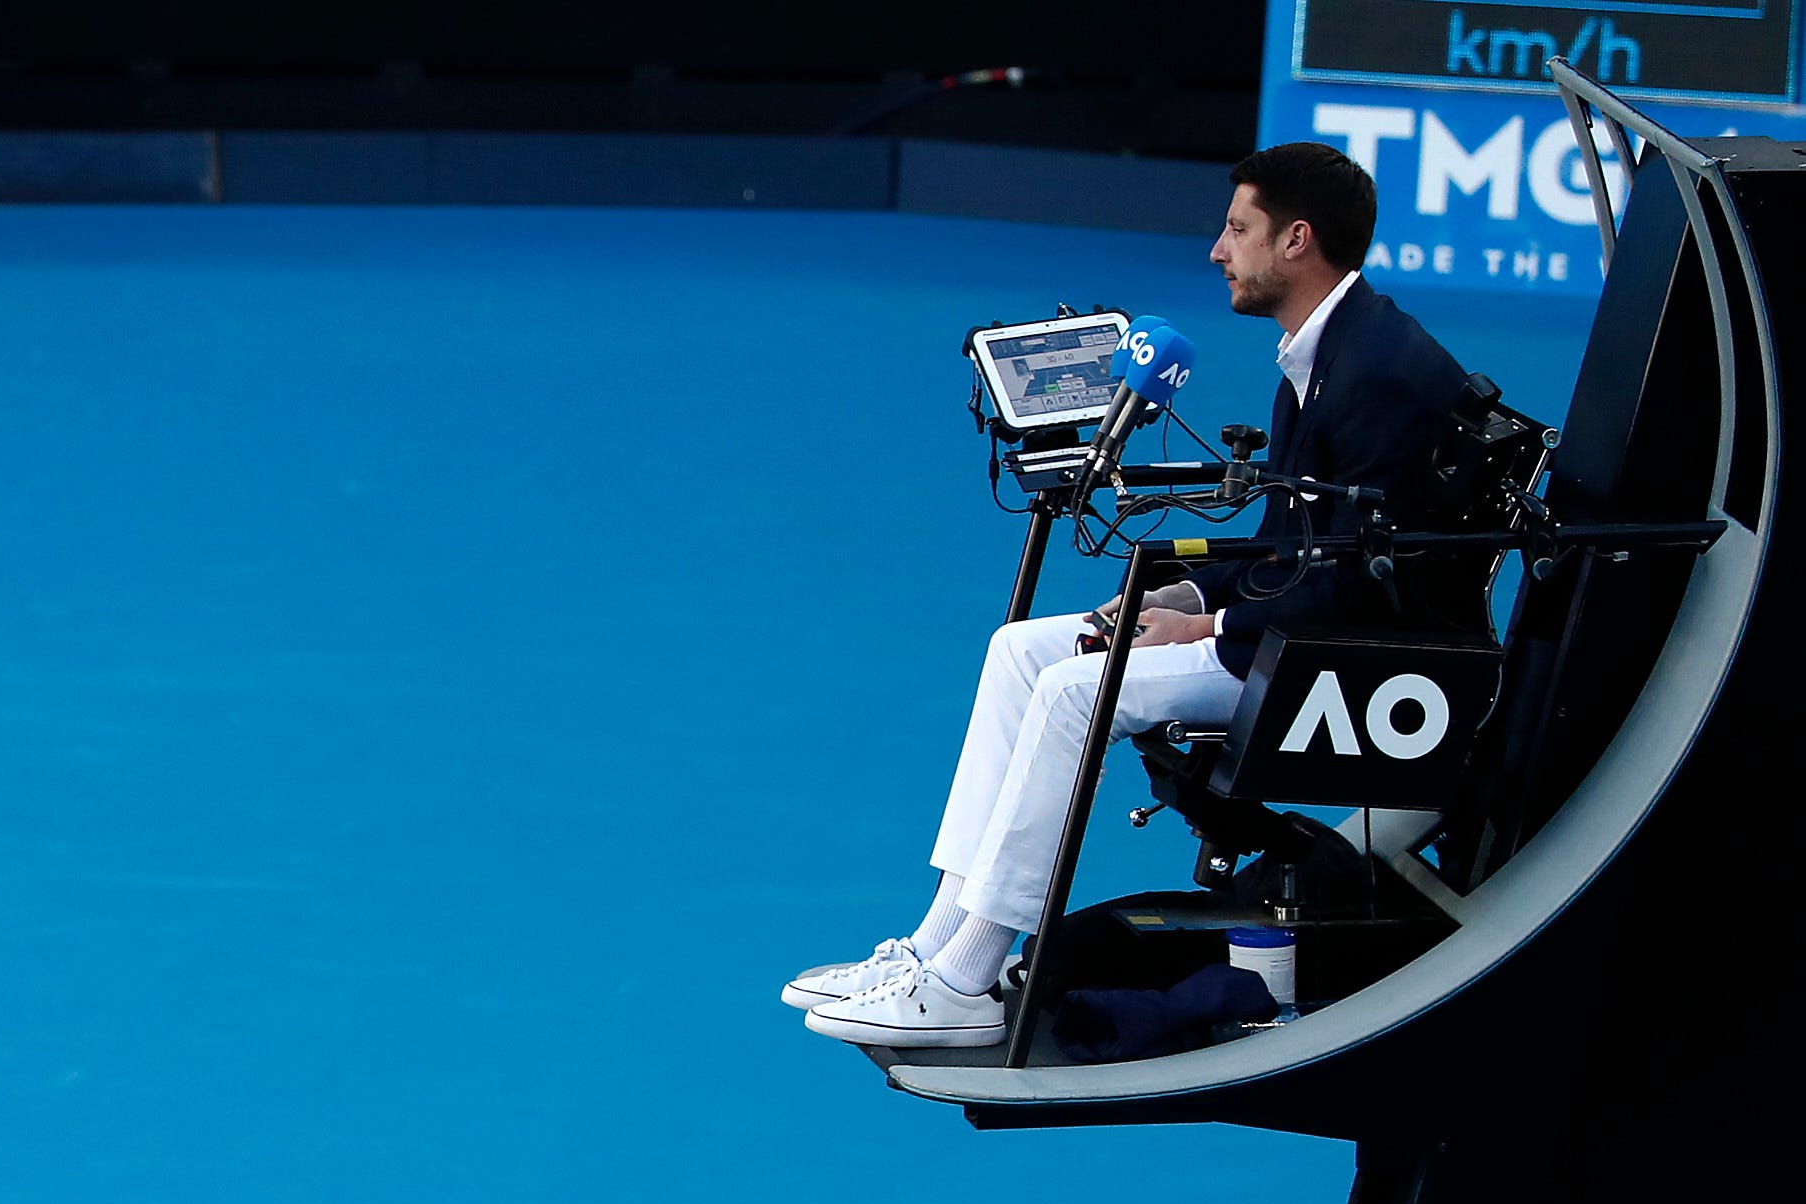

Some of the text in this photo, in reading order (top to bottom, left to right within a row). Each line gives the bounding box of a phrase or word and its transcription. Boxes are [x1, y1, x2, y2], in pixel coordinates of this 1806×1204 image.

[1446, 8, 1642, 84] km/h
[1313, 103, 1740, 226] TMG
[1364, 241, 1455, 275] ADE
[1482, 246, 1570, 282] THE
[1278, 670, 1450, 760] AO
